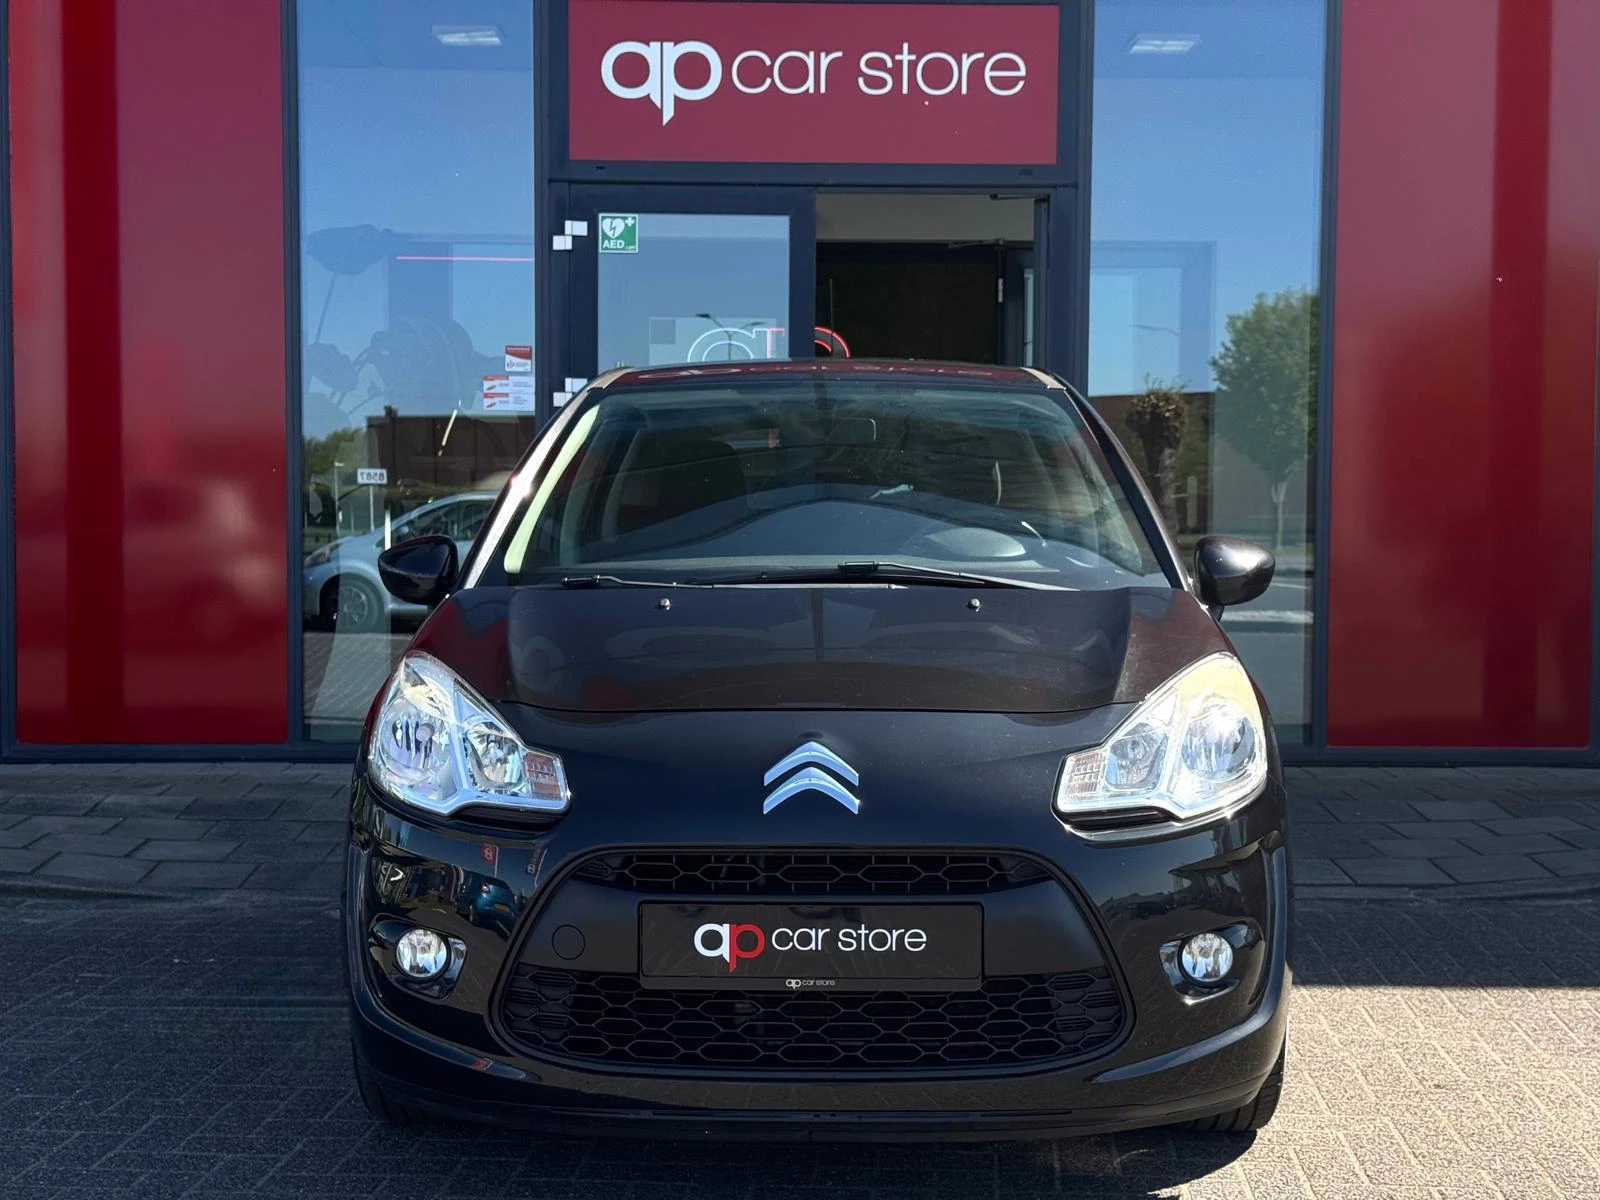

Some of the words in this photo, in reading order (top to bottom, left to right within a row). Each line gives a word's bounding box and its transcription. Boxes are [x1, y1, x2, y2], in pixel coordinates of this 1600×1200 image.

[731, 50, 843, 95] car
[857, 43, 1027, 97] store
[602, 239, 625, 249] AED
[771, 927, 830, 952] car
[838, 923, 928, 953] store
